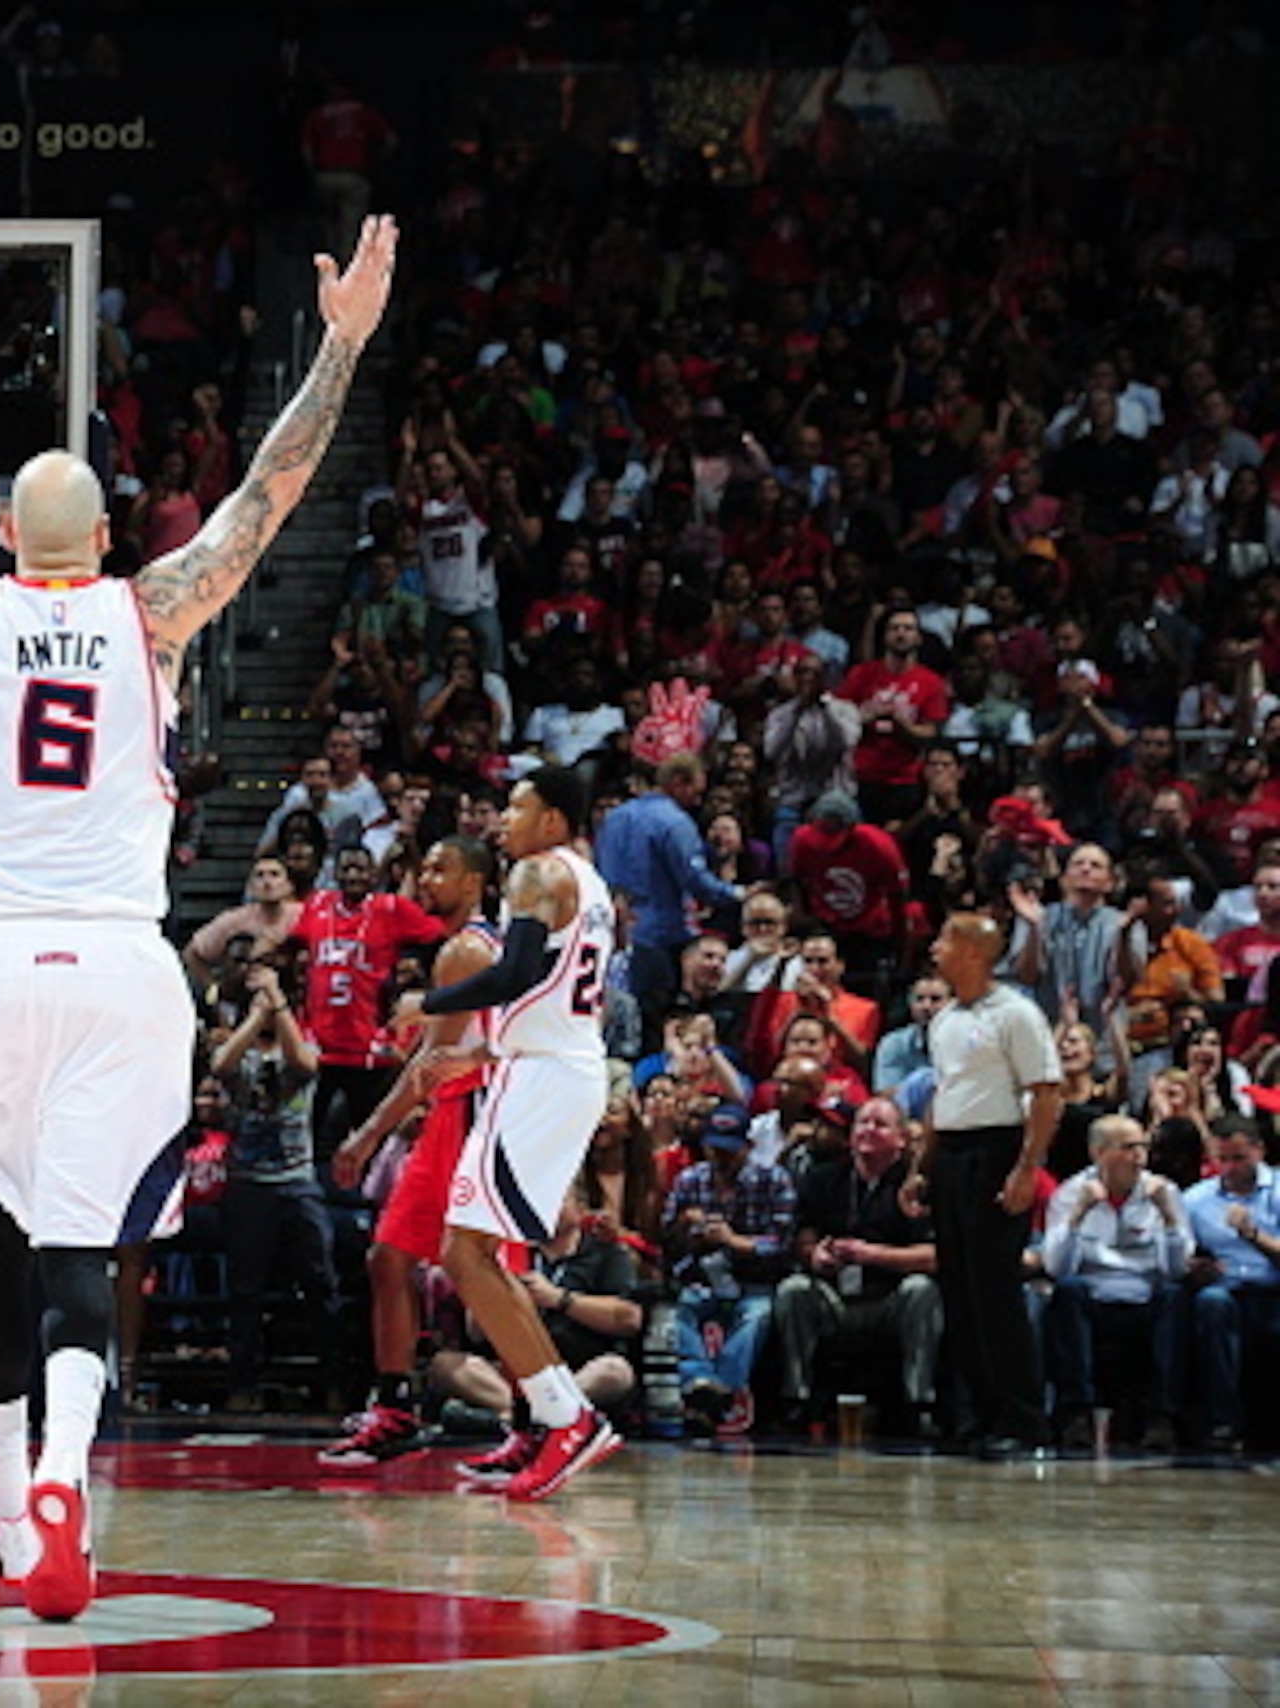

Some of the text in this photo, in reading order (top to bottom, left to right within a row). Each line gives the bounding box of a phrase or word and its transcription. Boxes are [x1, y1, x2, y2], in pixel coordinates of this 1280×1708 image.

[35, 113, 157, 160] good.
[17, 630, 109, 675] ANTIC
[17, 677, 99, 791] 6
[328, 970, 353, 1007] 5
